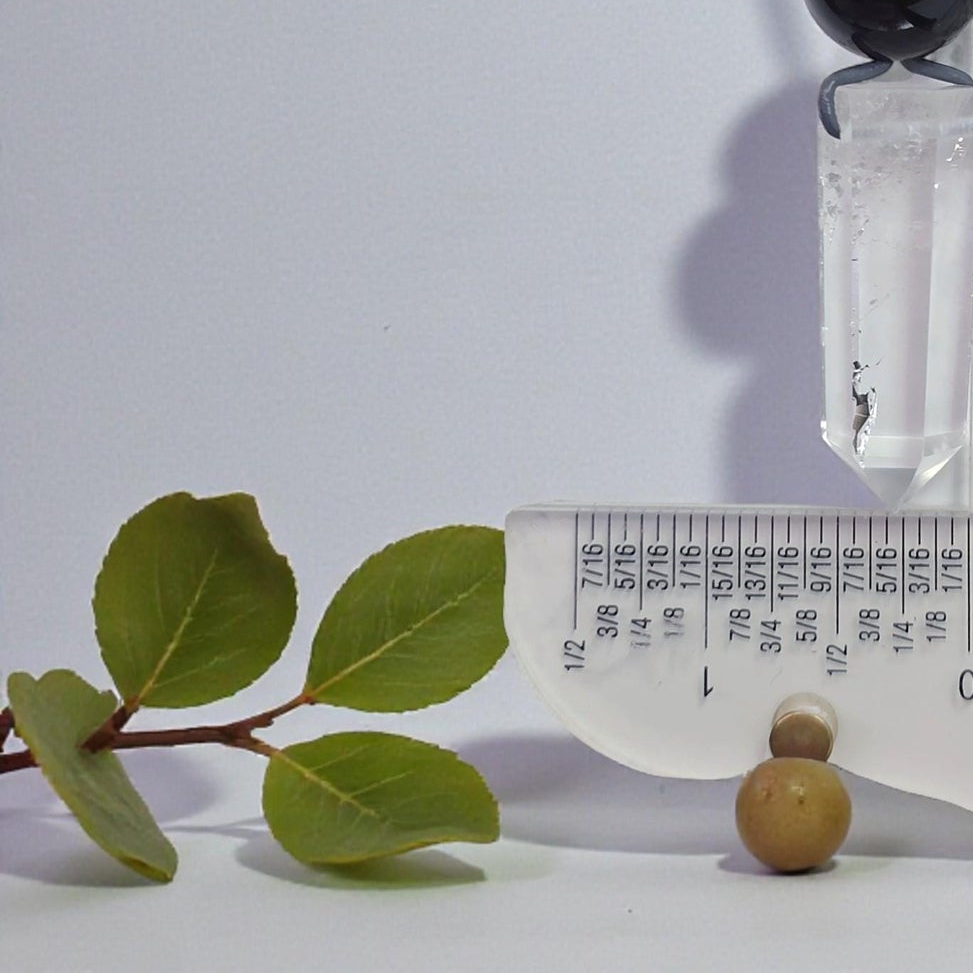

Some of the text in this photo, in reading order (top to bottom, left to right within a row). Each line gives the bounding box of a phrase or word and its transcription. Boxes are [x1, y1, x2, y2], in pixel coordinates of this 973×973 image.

[583, 544, 603, 588] 7/16
[615, 544, 636, 589] 5/16
[648, 545, 669, 590] 3/16
[681, 545, 701, 589] 1/16
[713, 546, 733, 600] 15/16
[745, 546, 766, 599] 13/16
[778, 547, 799, 600] 11/16
[811, 547, 831, 592] 9/16
[844, 547, 864, 592] 7/16
[876, 548, 897, 593] 5/16
[909, 548, 930, 593] 3/16
[943, 549, 963, 592] 1/16
[598, 605, 618, 638] 3/8
[730, 609, 751, 641] 7/8
[761, 619, 782, 653] 3/4
[797, 609, 817, 642] 5/8
[860, 609, 880, 641] 3/8
[894, 621, 914, 653] 1/4
[927, 610, 947, 642] 1/8
[565, 640, 585, 671] 1/2
[827, 644, 847, 675] 1/2
[704, 666, 713, 697] 1
